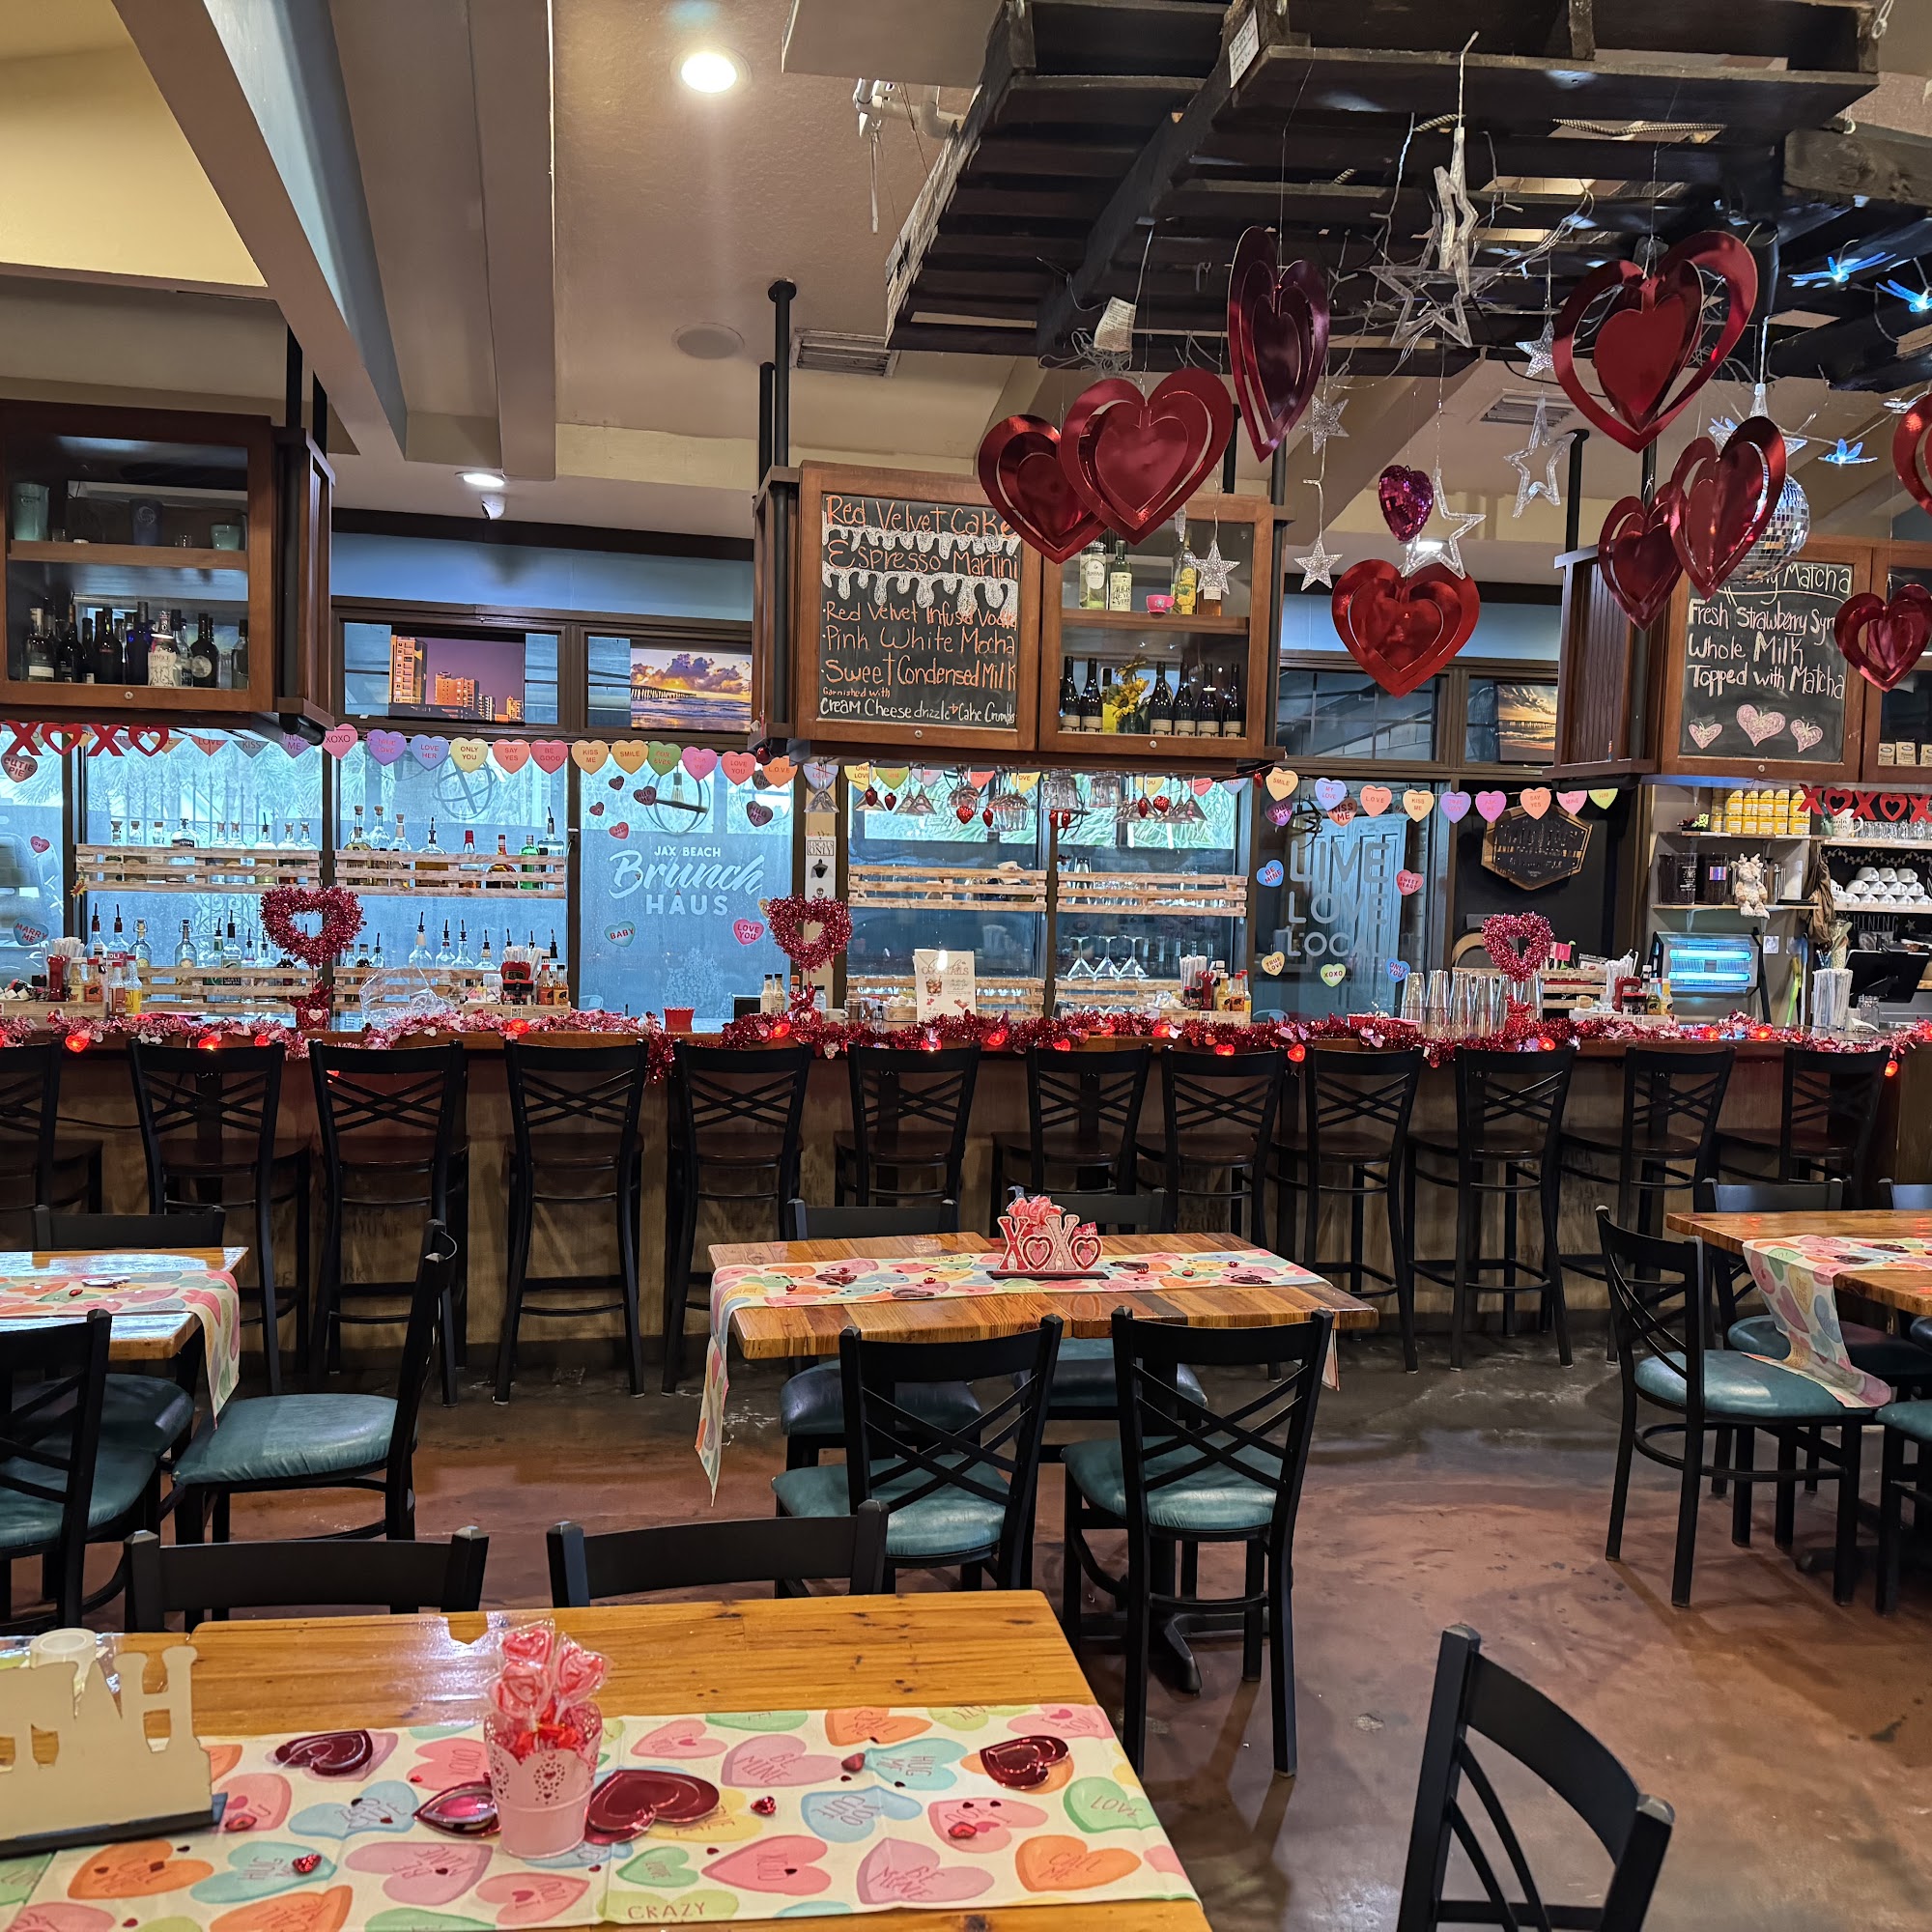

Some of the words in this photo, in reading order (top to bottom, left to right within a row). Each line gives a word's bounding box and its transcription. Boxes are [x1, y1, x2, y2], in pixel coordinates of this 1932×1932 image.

[826, 496, 867, 526] Red
[876, 501, 948, 531] Velvet
[951, 508, 1017, 538] Cake
[828, 539, 941, 572] Espresso
[953, 551, 1018, 579] Martini
[1783, 563, 1852, 594] Matcha
[826, 601, 861, 622] Red
[867, 600, 918, 623] Velvet
[1690, 599, 1729, 630] Fresh
[1736, 601, 1807, 637] Strawberry
[826, 626, 868, 651] Pink
[880, 627, 953, 653] White
[960, 627, 1015, 657] Mocha
[1689, 633, 1746, 661] Whole
[1754, 631, 1804, 669] Milk
[826, 652, 895, 686] Sweet
[897, 655, 980, 688] Condensed
[981, 663, 1016, 691] Milk
[1688, 663, 1748, 696] Topped
[1753, 667, 1785, 690] with
[1789, 664, 1845, 699] Matcha
[823, 687, 867, 697] Garnished
[868, 688, 891, 698] with
[865, 697, 911, 719] Cheese
[958, 703, 981, 722] Cake
[326, 734, 351, 744] XOXO
[3, 756, 34, 773] CUTIE
[8, 766, 25, 778] PIE
[1272, 777, 1291, 786] SMILE
[749, 804, 767, 817] HUG
[750, 811, 761, 821] ME
[1331, 804, 1353, 814] KISS
[1337, 811, 1350, 821] ME
[654, 845, 676, 857] JAX
[682, 846, 722, 858] BEACH
[1290, 840, 1390, 883] LIVE
[609, 850, 765, 899] Brunch
[1264, 867, 1276, 875] BE
[1264, 870, 1283, 884] MINE
[645, 894, 728, 916] HAUS
[1288, 891, 1388, 925] LOVE
[15, 923, 47, 940] MARRY
[610, 927, 634, 940] BABY
[737, 924, 760, 934] LOVE
[738, 931, 756, 941] YOU
[21, 933, 35, 944] ME
[1287, 931, 1380, 957] LOCAL
[1265, 957, 1281, 967] TRUE
[1267, 962, 1283, 972] LOVE
[1389, 961, 1407, 973] ONLY
[1389, 968, 1404, 978] YOU
[733, 1755, 792, 1784] MINE
[770, 1752, 802, 1770] BE
[876, 1756, 905, 1772] ME
[906, 1755, 937, 1776] HUG
[1090, 1795, 1143, 1817] LOVE
[1049, 1853, 1101, 1872] CALL
[867, 1865, 933, 1898] MINE
[904, 1865, 946, 1884] BE
[628, 1902, 705, 1919] CRAZY
